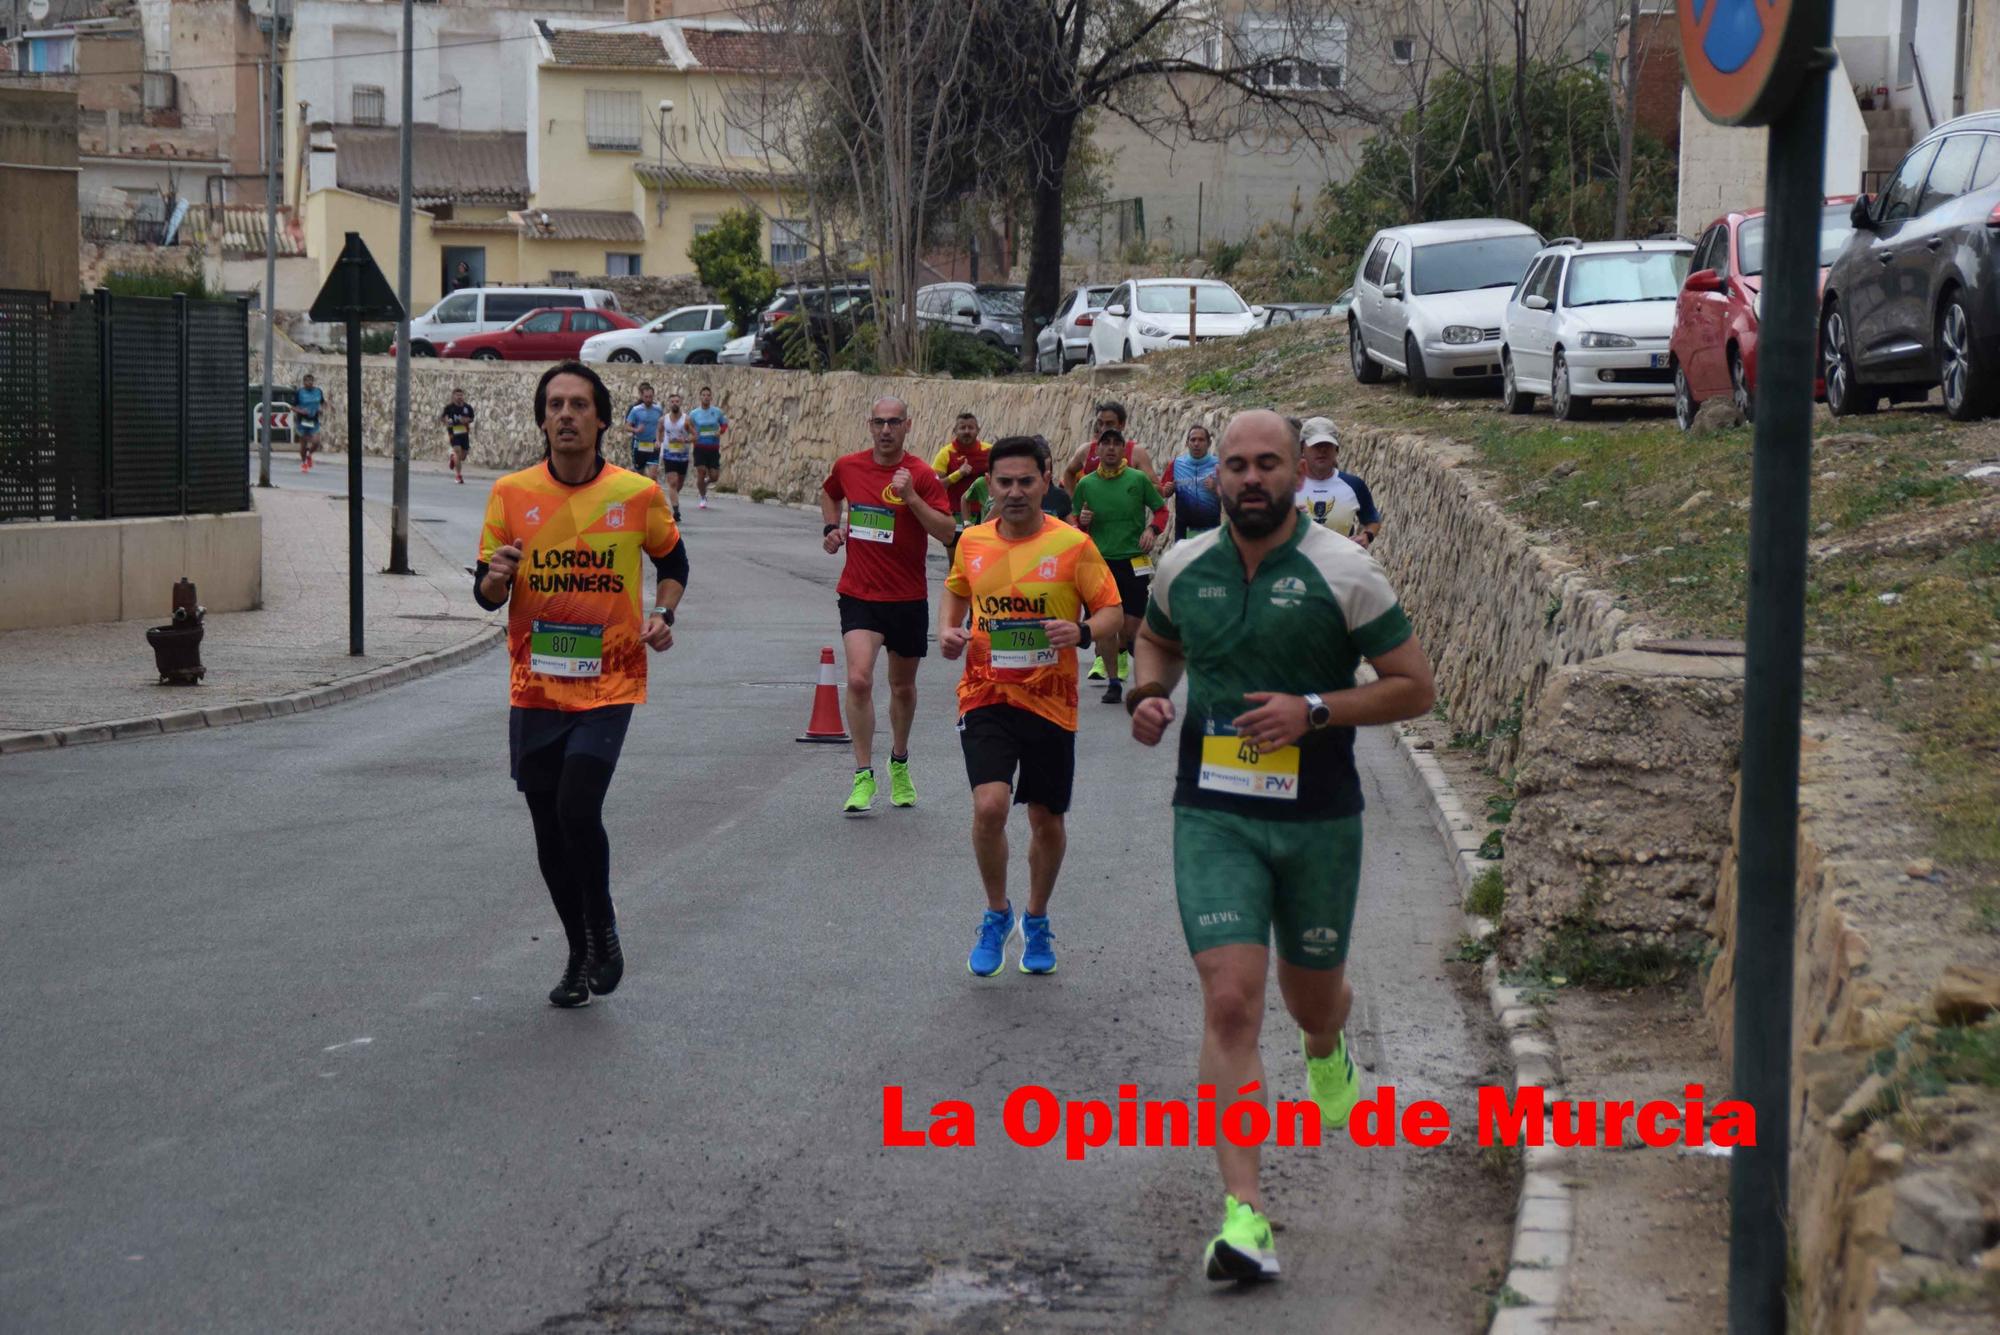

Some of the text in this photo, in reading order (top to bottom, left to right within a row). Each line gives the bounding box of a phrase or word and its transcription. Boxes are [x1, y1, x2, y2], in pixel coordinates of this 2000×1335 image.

[863, 512, 879, 526] 711
[532, 544, 618, 570] LORQUÍ
[529, 574, 624, 593] RUNNERS
[976, 592, 1049, 616] LORQUÍ
[552, 635, 577, 654] 807
[1011, 631, 1035, 648] 796
